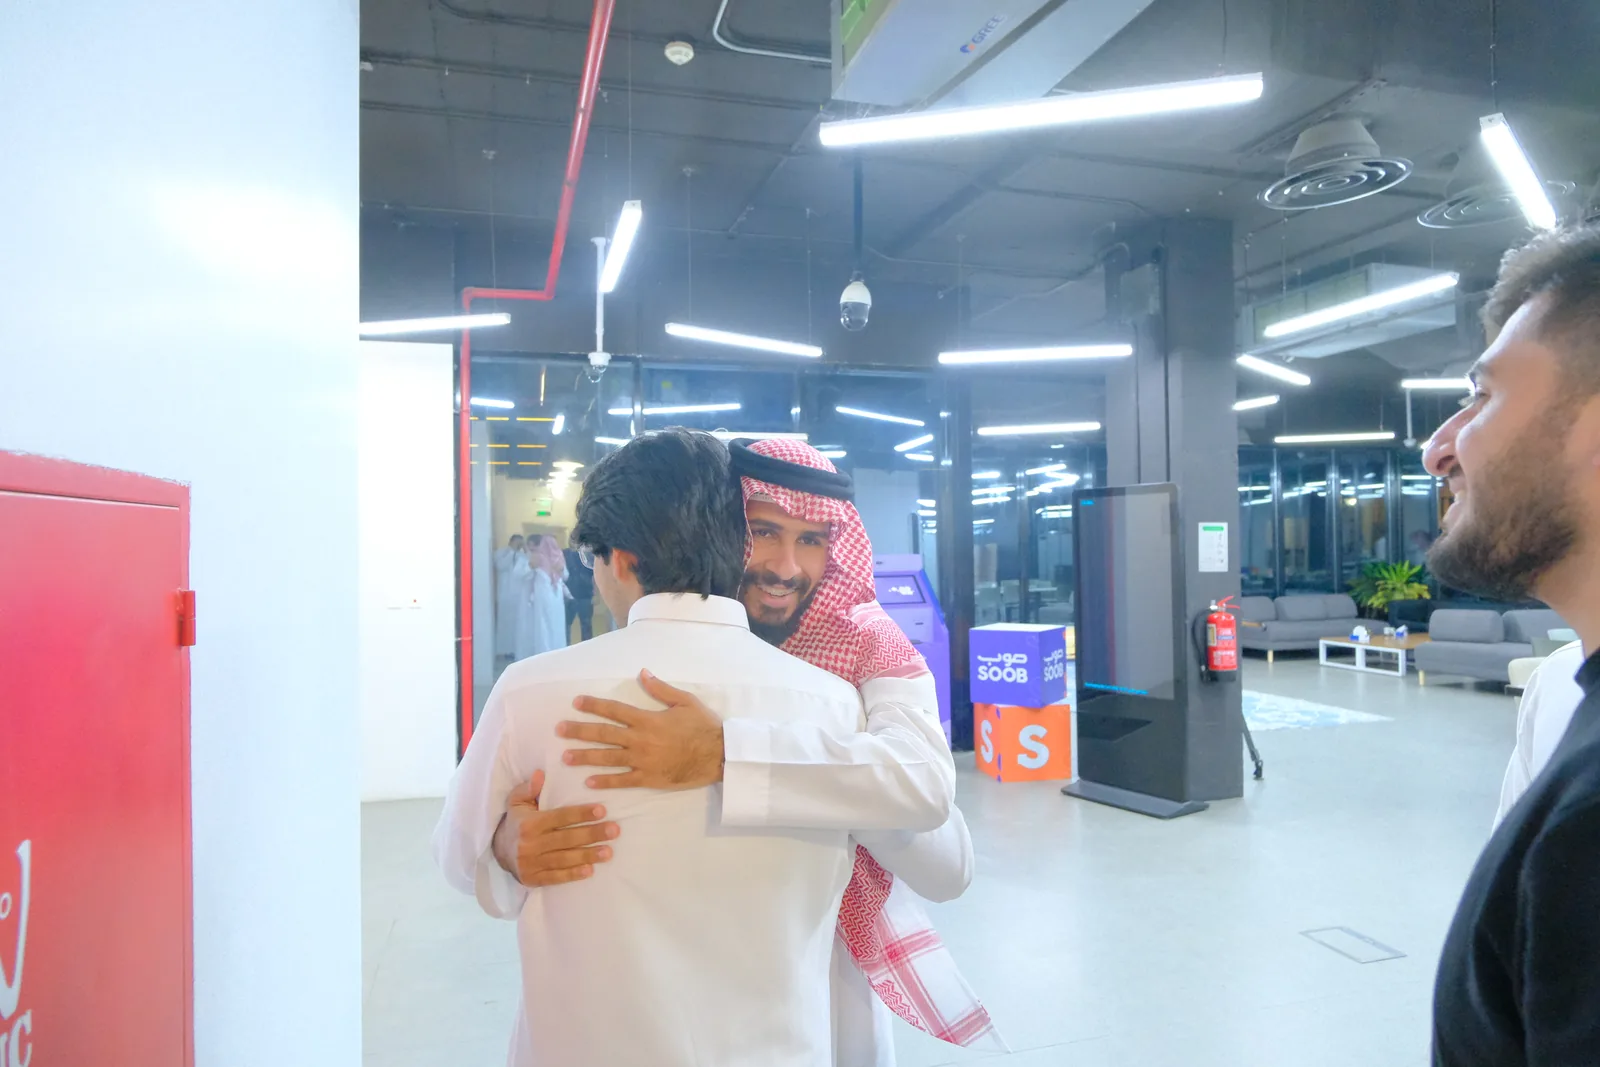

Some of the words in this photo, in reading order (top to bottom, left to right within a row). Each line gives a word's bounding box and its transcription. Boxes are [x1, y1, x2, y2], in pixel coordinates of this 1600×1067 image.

[977, 652, 1028, 667] صوب
[977, 665, 1028, 684] SOOB
[1043, 662, 1064, 682] SOOB
[980, 719, 994, 763] S
[1017, 724, 1050, 769] S
